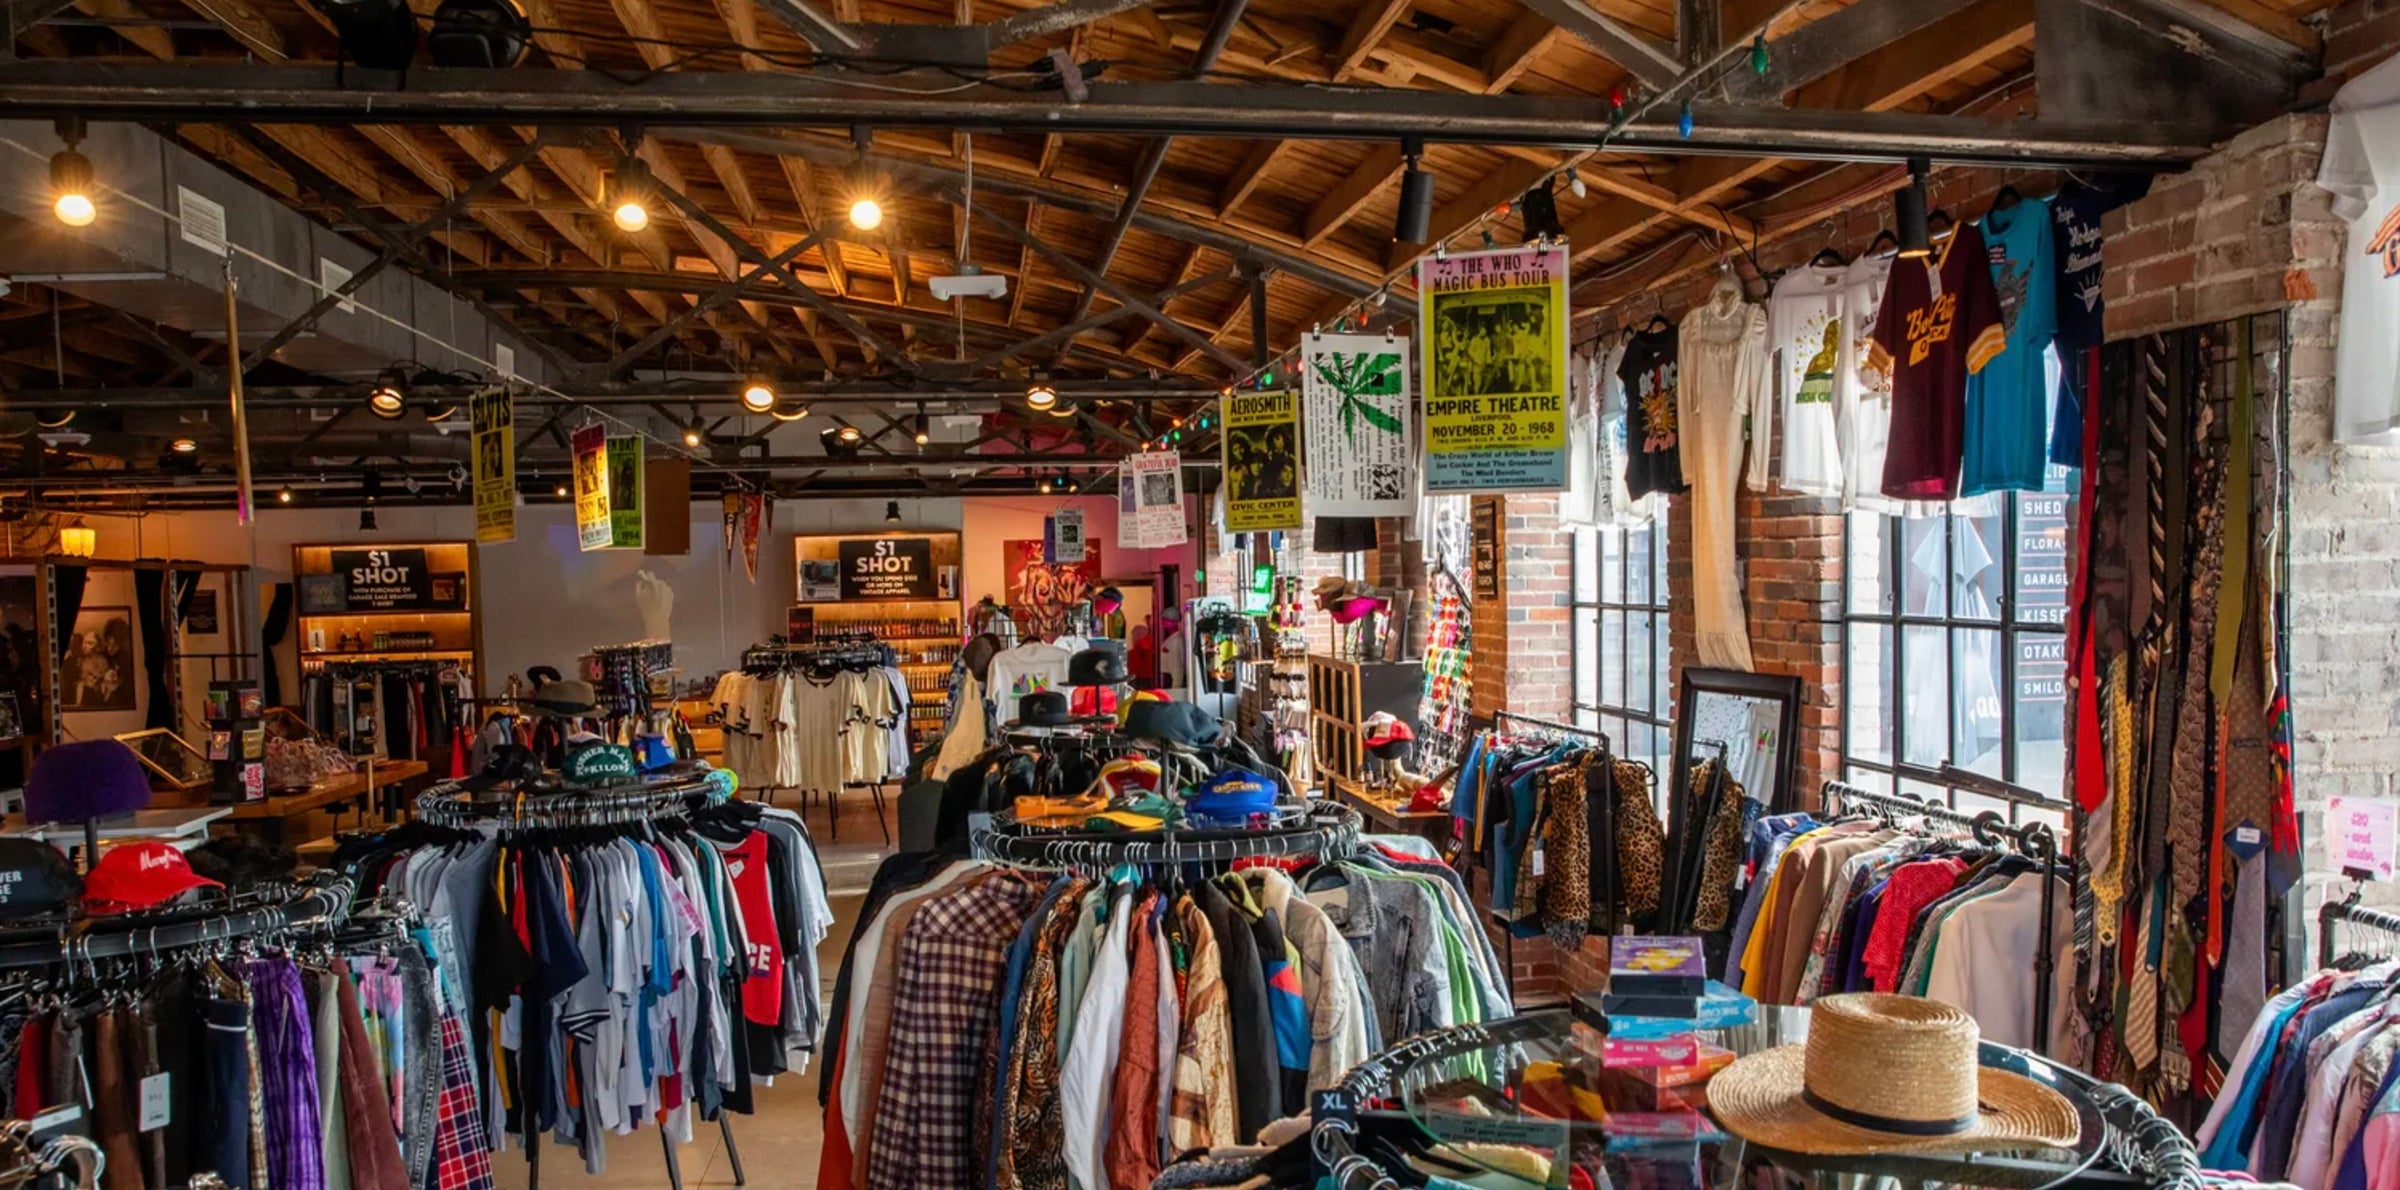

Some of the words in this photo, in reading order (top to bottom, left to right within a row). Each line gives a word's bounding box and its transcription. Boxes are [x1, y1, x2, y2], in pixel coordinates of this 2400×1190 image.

[1461, 258, 1484, 275] THE
[1491, 254, 1521, 272] WHO
[1433, 275, 1475, 293] MAGIC
[1481, 274, 1507, 289] BUS
[1513, 270, 1550, 287] TOUR
[1230, 395, 1291, 415] AEROSMITH
[1426, 398, 1482, 417] EMPIRE
[1487, 395, 1561, 414] THEATRE
[1470, 414, 1513, 422] LIVERPOOL
[1432, 423, 1495, 439] NOVEMBER
[1501, 422, 1518, 435] 20
[1528, 421, 1555, 434] 1968
[1434, 451, 1447, 461] The
[1447, 451, 1468, 461] Crazy
[1470, 450, 1493, 459] World
[1494, 450, 1502, 458] of
[1504, 449, 1528, 458] Arthur
[1530, 448, 1555, 457] Brown
[1449, 460, 1474, 469] Cocker
[1476, 459, 1491, 468] And
[1492, 458, 1506, 467] The
[1460, 469, 1473, 477] The
[1495, 468, 1527, 476] Benders
[2045, 465, 2067, 479] LID
[1231, 503, 1256, 512] CIVIC
[1257, 500, 1295, 510] CENTER
[2024, 501, 2062, 515] SHED
[875, 540, 896, 557] $1
[368, 550, 391, 568] $1
[856, 556, 912, 573] SHOT
[352, 566, 410, 584] SHOT
[370, 586, 402, 594] PURCHASE
[885, 587, 911, 595] APPAREL
[2024, 645, 2066, 659] OTAK
[2023, 682, 2066, 694] SMILO
[1321, 1092, 1348, 1110] XL
